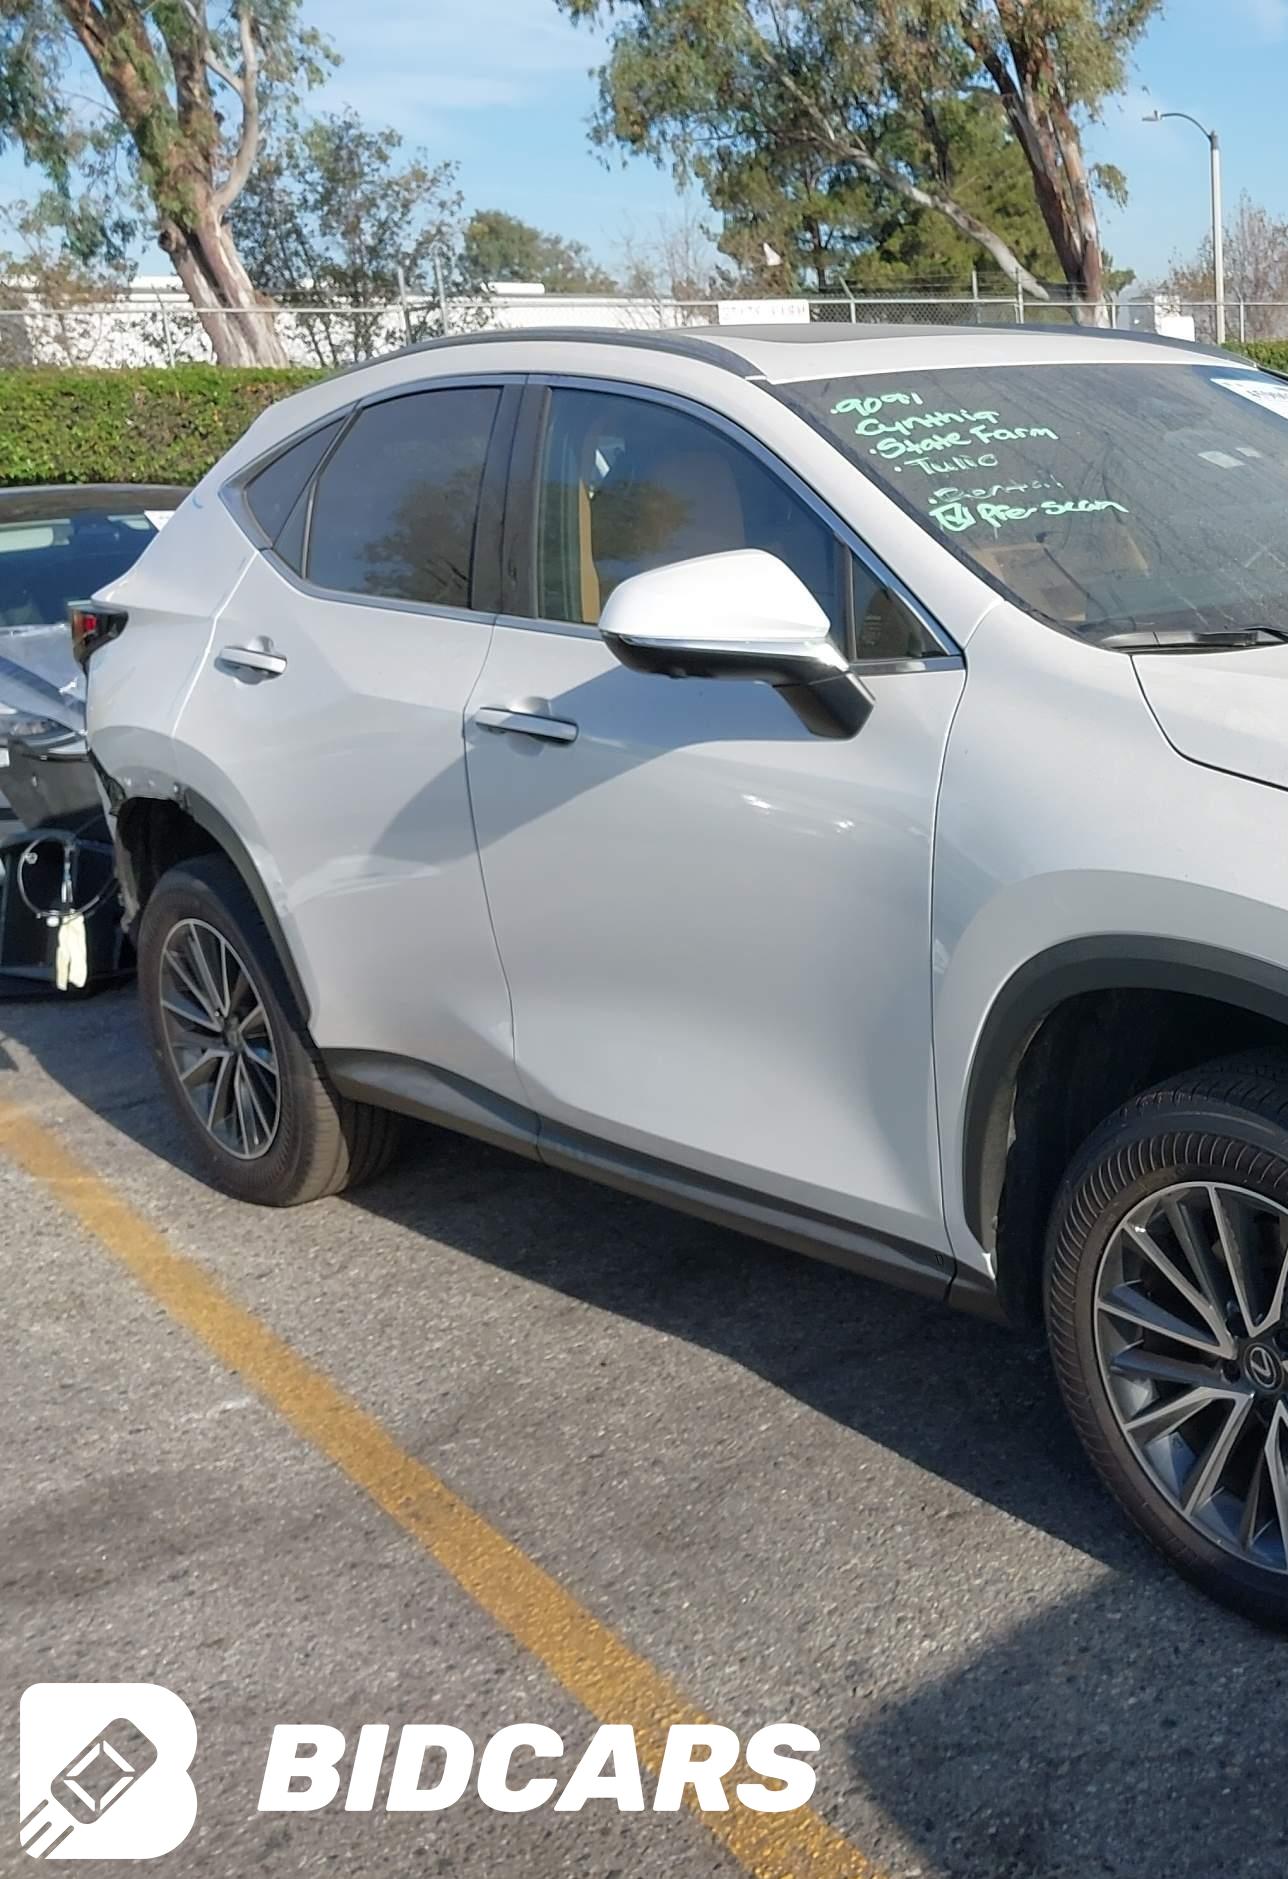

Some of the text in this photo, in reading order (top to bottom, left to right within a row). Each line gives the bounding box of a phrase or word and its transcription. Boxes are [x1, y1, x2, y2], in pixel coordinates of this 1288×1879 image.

[855, 408, 1000, 436] Cynthia
[876, 424, 1059, 459] State Farm
